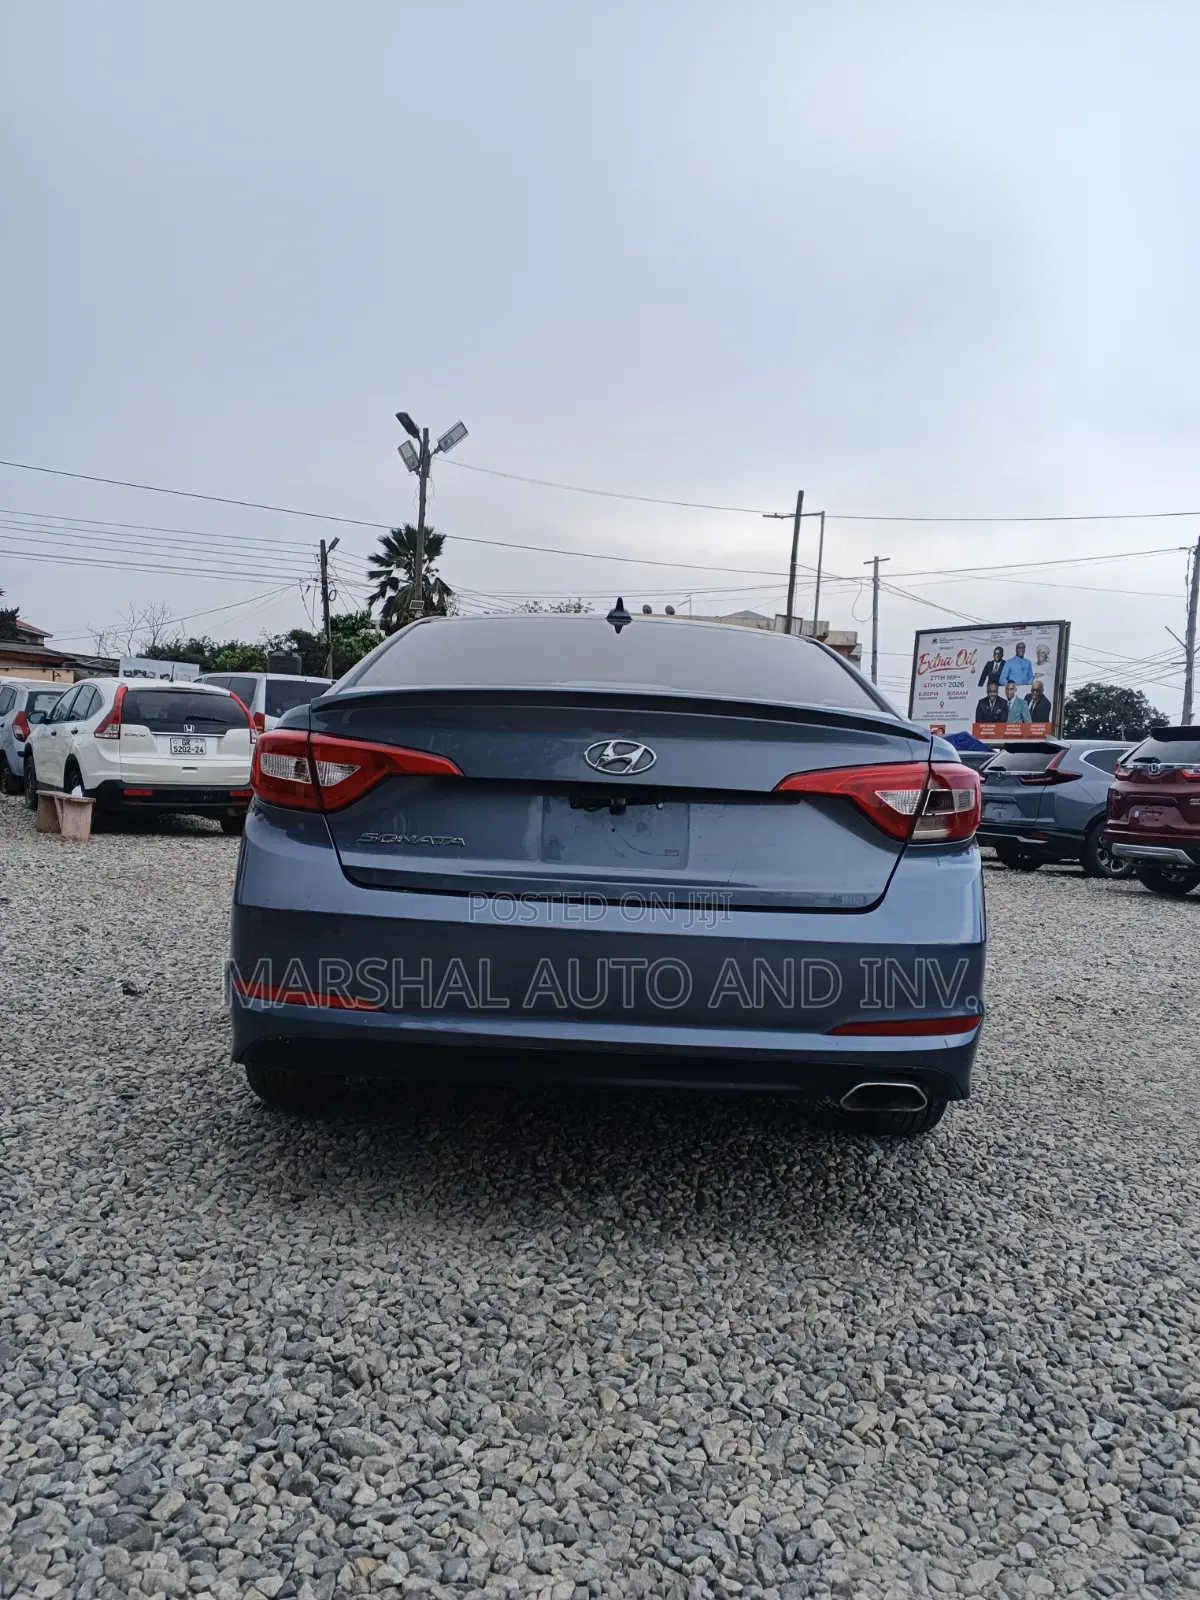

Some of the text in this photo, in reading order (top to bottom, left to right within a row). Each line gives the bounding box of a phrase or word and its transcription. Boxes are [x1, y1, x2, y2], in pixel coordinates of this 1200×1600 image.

[917, 648, 978, 675] Extra Oil
[173, 745, 204, 753] 5202-24
[356, 832, 466, 847] SONATA
